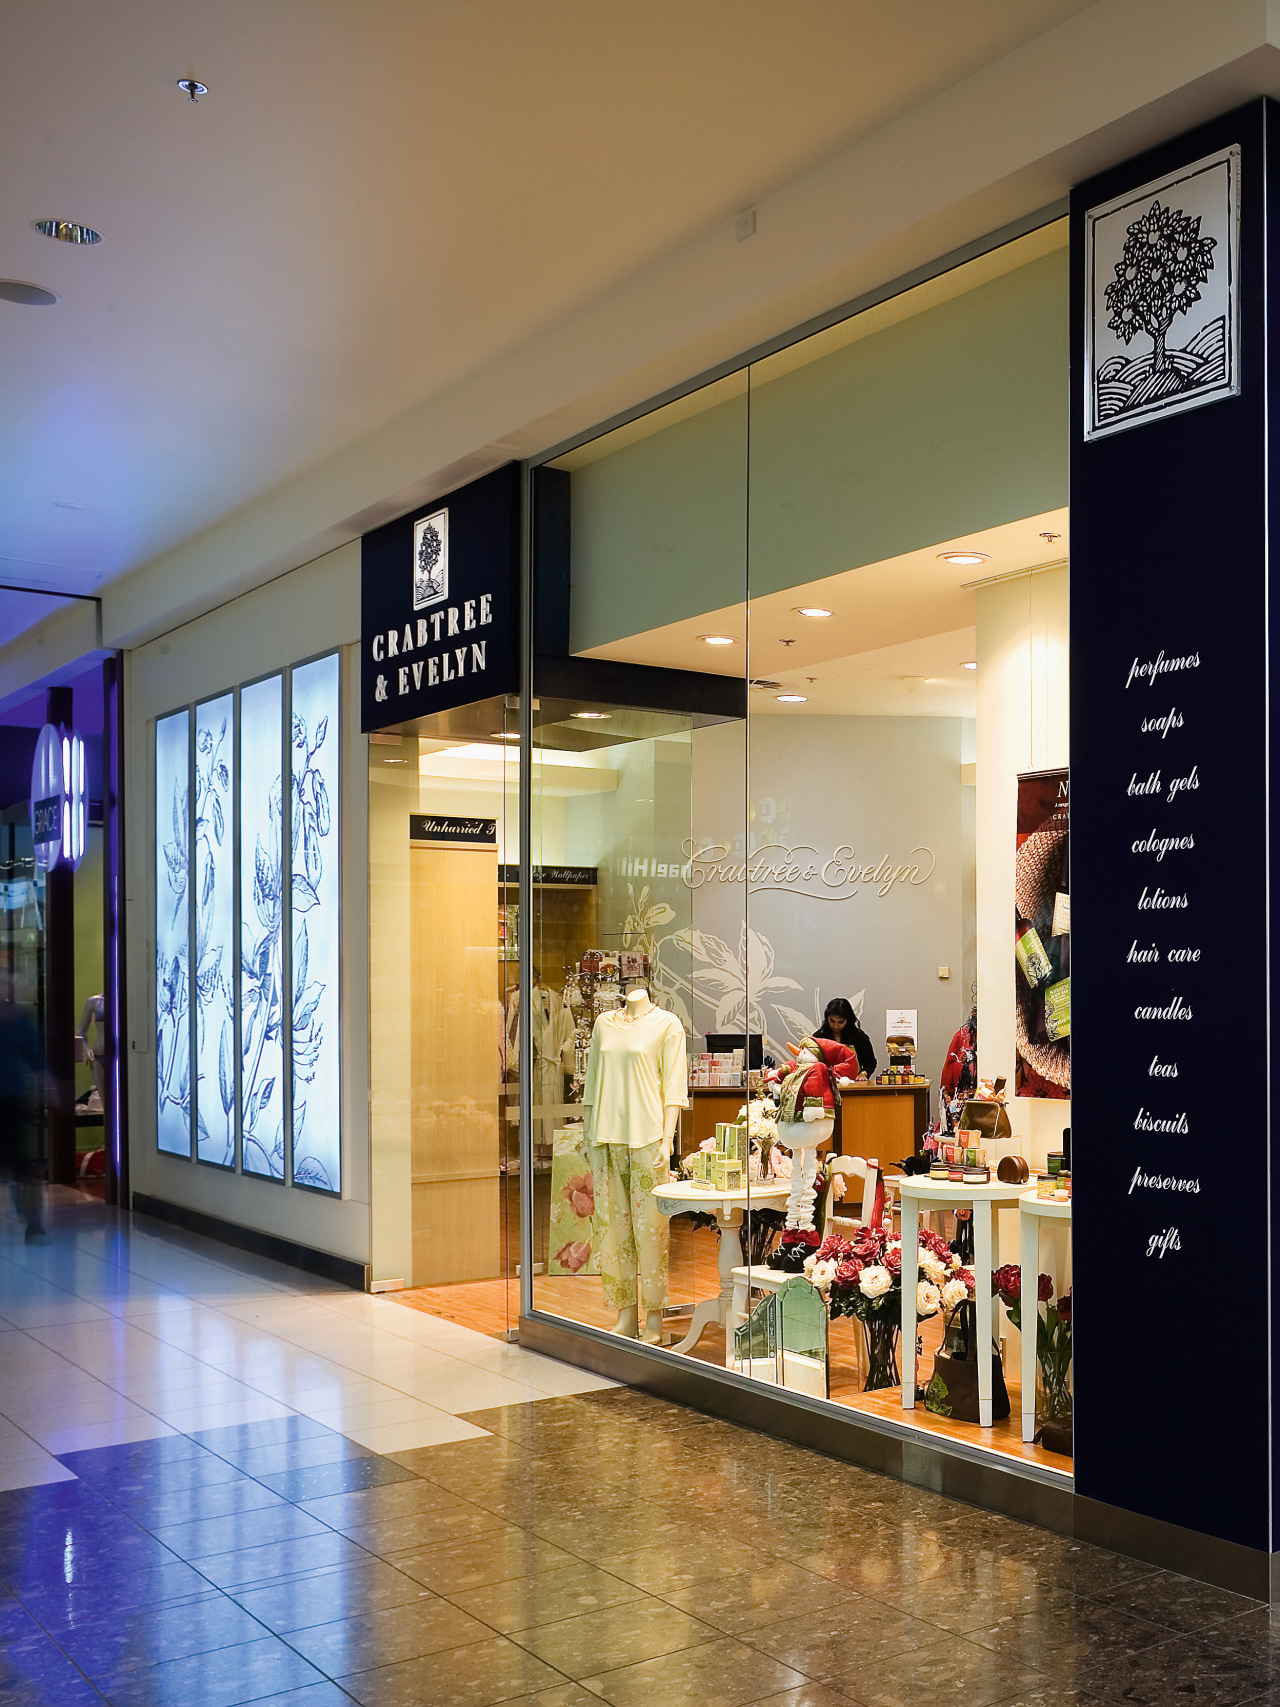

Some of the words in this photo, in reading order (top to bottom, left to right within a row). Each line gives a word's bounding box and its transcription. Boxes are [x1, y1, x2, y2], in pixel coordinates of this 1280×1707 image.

[372, 594, 493, 662] CRABTREE
[375, 675, 388, 702] &
[398, 641, 487, 695] EVELYN
[1126, 650, 1200, 688] perfumes
[1141, 707, 1184, 739] soaps
[1126, 770, 1161, 796] bath
[1167, 766, 1200, 802] gels
[35, 805, 58, 834] GRACE
[421, 820, 484, 834] Unhurried
[1132, 829, 1194, 862] colognes
[551, 869, 588, 881] Wallpaper
[803, 865, 818, 880] &
[821, 846, 935, 897] Evelyn
[1138, 887, 1188, 909] lotions
[1127, 940, 1159, 962] hair
[1168, 948, 1200, 962] care
[1134, 997, 1193, 1020] candles
[1148, 1055, 1178, 1077] teas
[1133, 1108, 1188, 1134] biscuits
[1128, 1167, 1200, 1194] preserves
[1146, 1227, 1181, 1258] gifts
